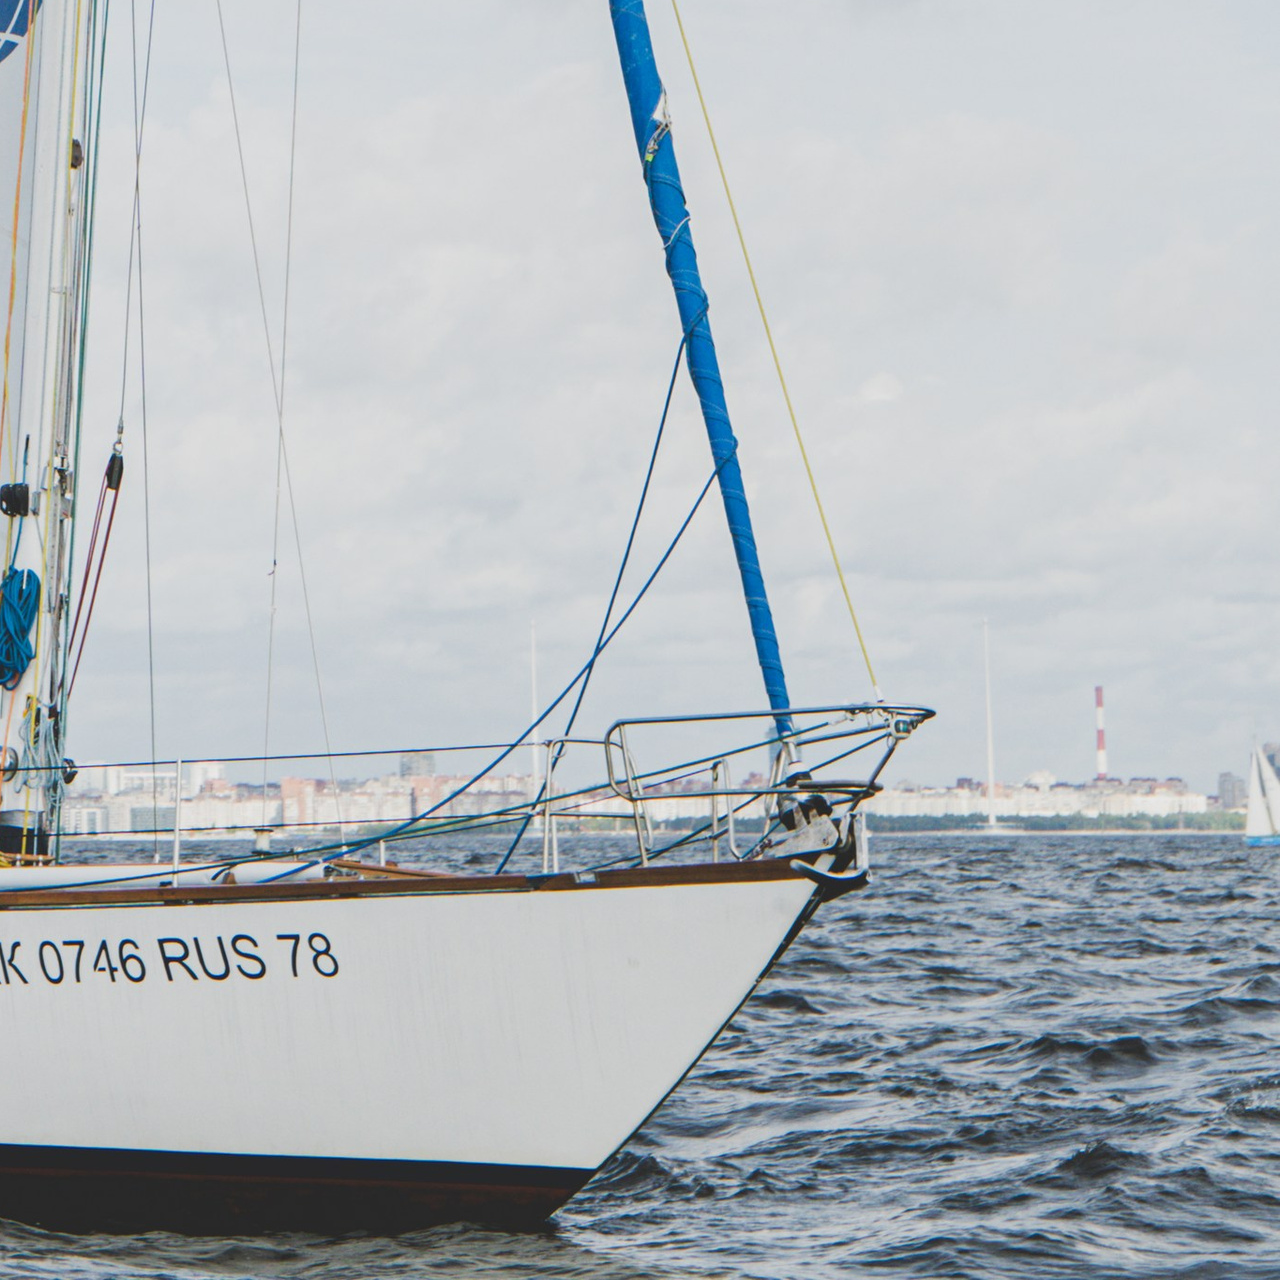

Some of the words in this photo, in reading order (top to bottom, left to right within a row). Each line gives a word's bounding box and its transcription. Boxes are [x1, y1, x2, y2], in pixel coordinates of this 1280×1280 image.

[38, 939, 146, 984] 0746
[157, 934, 266, 982] RUS
[276, 932, 339, 978] 78
